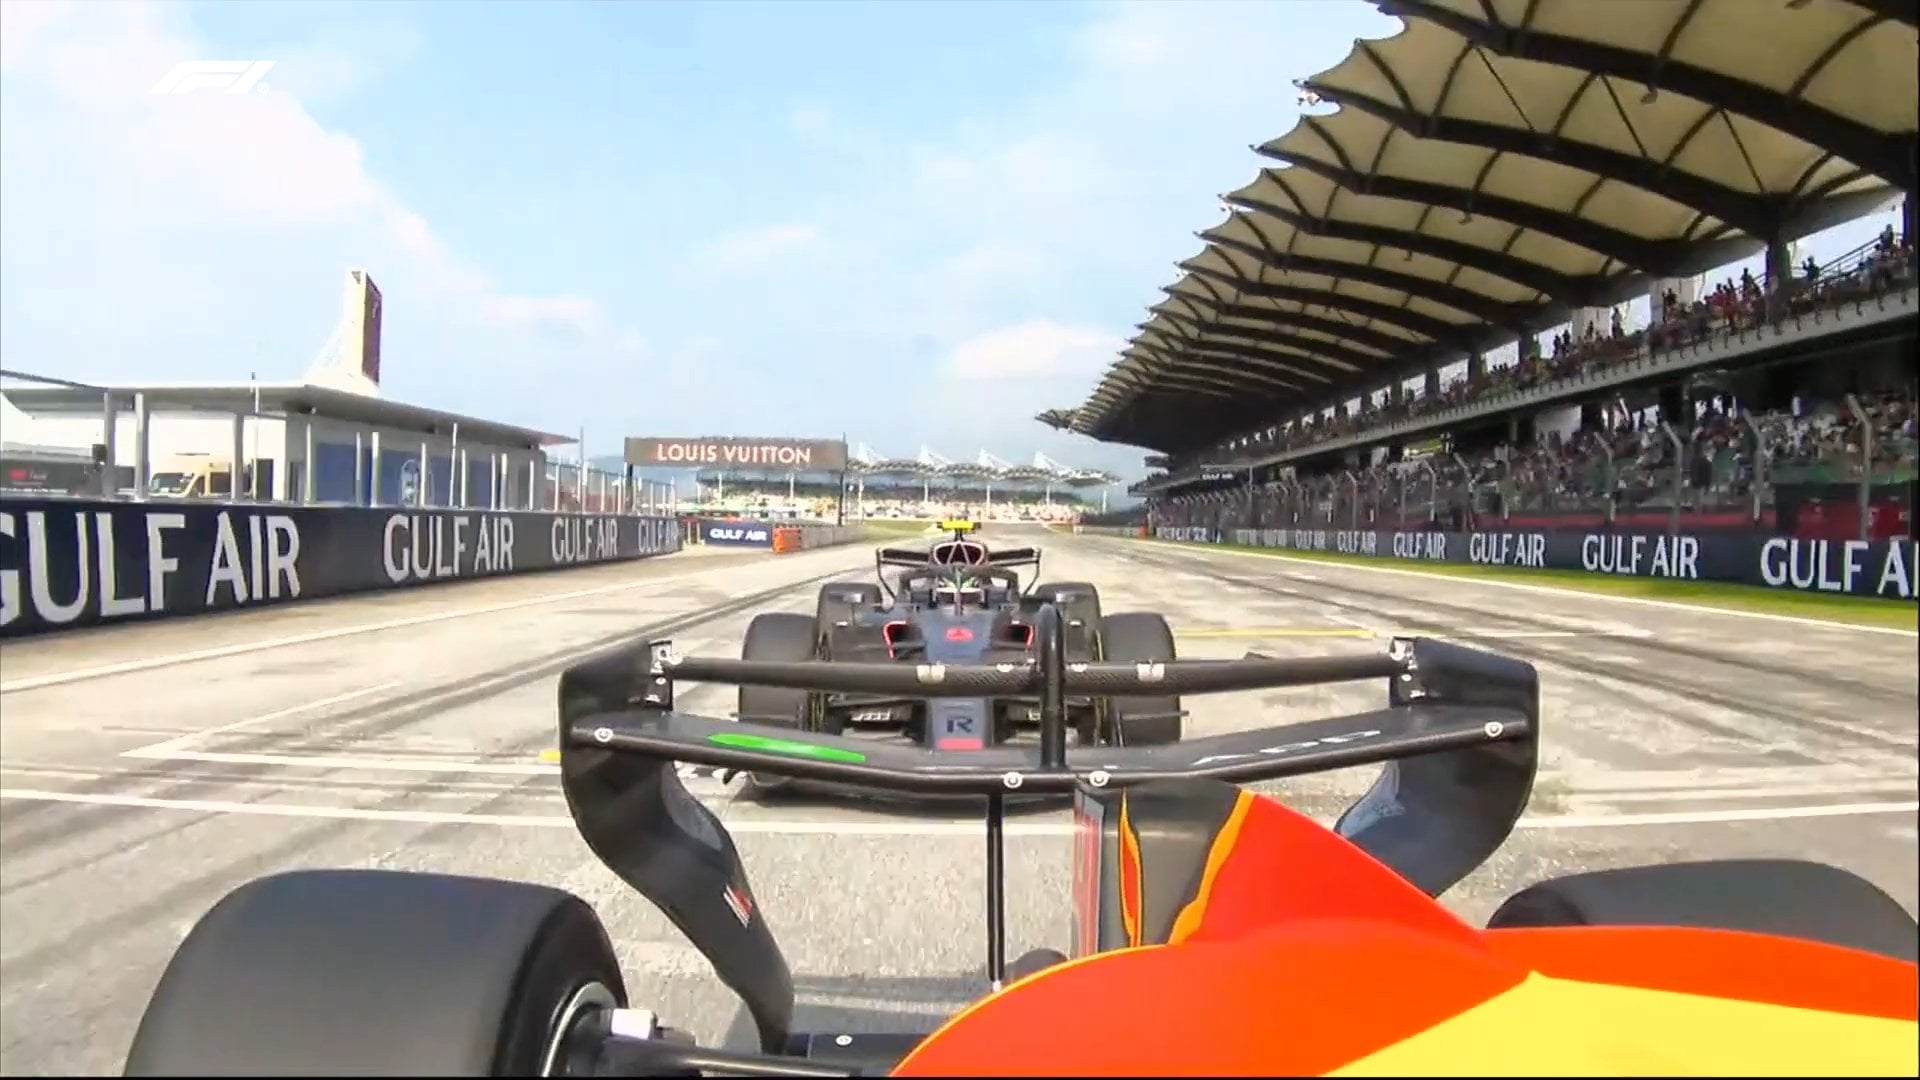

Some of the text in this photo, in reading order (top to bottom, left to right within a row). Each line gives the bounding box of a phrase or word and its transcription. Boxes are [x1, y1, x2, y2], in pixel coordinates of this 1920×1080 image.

[657, 443, 811, 464] LOUIS VUITTON
[384, 513, 514, 582] GULF AIR
[551, 517, 618, 562] GULF AIR
[709, 528, 768, 541] GULF AIR
[1393, 532, 1445, 560] GULF AIR
[1470, 533, 1545, 567] GULF AIR
[1582, 534, 1698, 579] GULF AIR
[206, 511, 300, 606] AIR
[1761, 538, 1869, 592] GULF
